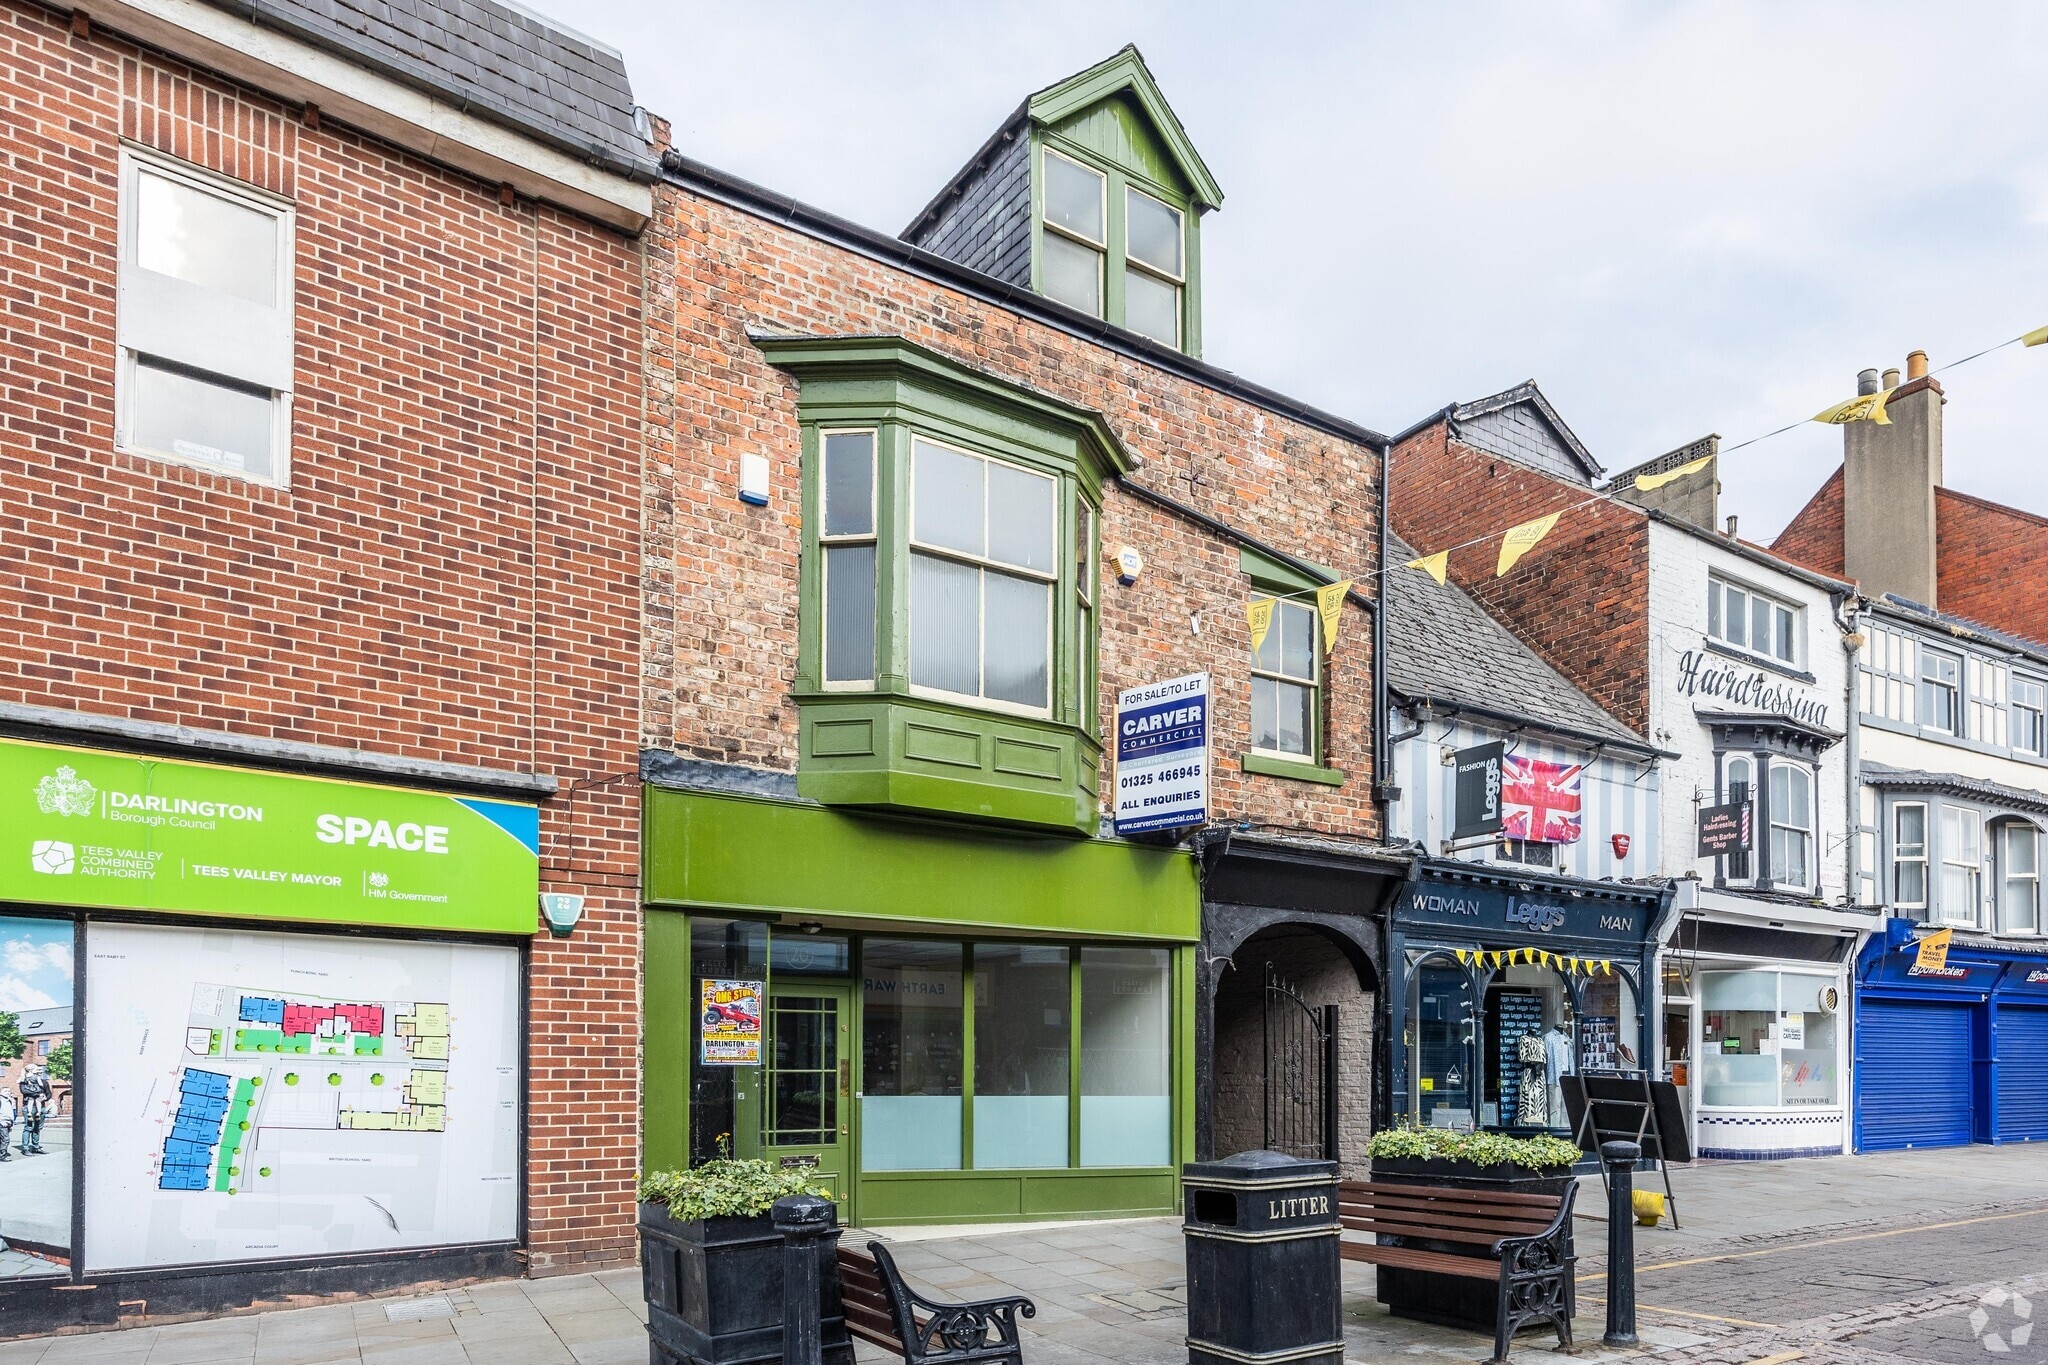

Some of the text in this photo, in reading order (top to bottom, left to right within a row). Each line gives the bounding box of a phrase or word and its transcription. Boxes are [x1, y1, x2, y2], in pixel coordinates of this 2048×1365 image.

[1125, 680, 1202, 706] FOR SALE/TO LET
[1677, 650, 1829, 726] Hairdressing
[1122, 705, 1202, 736] CARVER
[1122, 728, 1202, 750] COMMERCIAL
[1121, 765, 1201, 788] 01325 466945
[1458, 760, 1486, 774] FASHION
[1120, 790, 1200, 810] ALL ENQUIRIES
[1482, 758, 1500, 822] Leggs
[111, 791, 263, 822] DARLINGTON
[111, 810, 216, 830] Borough Council
[1118, 812, 1204, 830] www.carvercommercial.co.uk
[1711, 814, 1729, 823] Ladies
[316, 814, 448, 854] SPACE
[1702, 832, 1738, 843] Gents Barber
[80, 846, 164, 861] TEES VALLEY
[80, 856, 154, 870] COMBINED
[80, 867, 156, 880] AUTHORITY
[192, 864, 342, 886] TEES VALLEY MAYOR
[368, 888, 448, 903] HM Government
[1412, 894, 1480, 916] WOMAN
[1506, 896, 1566, 932] Leggs
[1600, 914, 1633, 932] MAN
[716, 992, 732, 1003] OMG
[1269, 1196, 1329, 1219] LITTER
